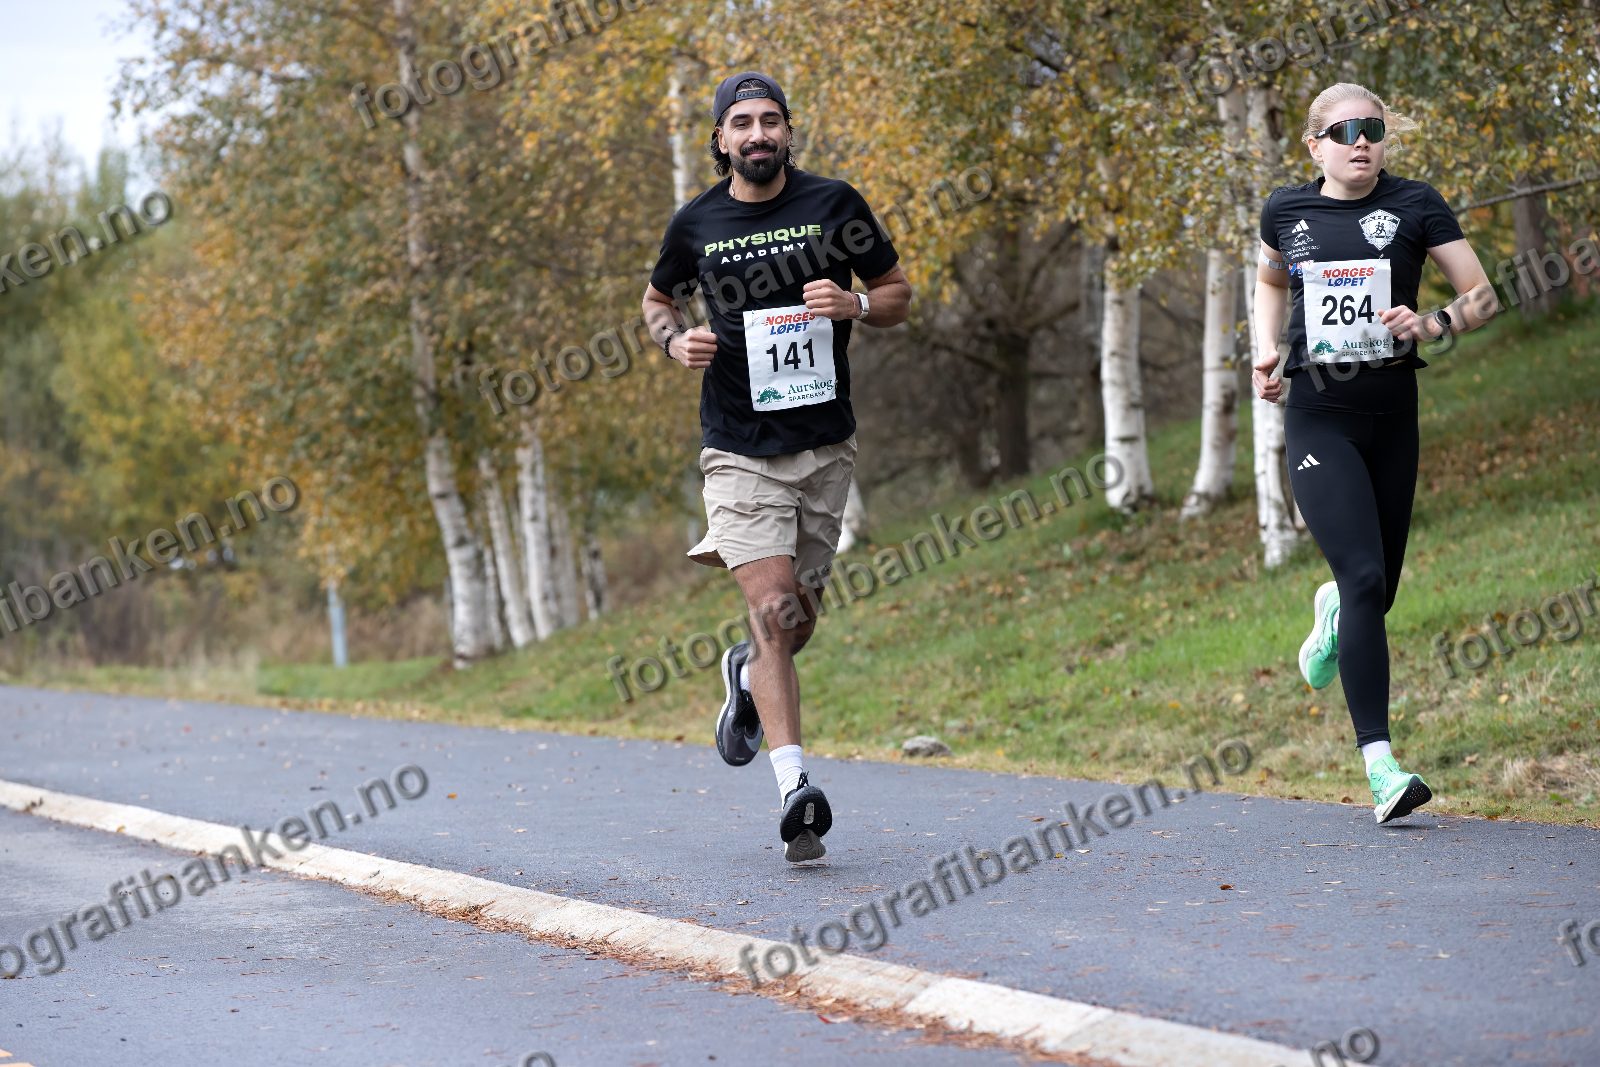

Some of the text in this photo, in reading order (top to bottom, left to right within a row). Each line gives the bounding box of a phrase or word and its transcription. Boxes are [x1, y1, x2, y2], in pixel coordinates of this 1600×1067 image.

[704, 224, 822, 257] PHYSIQUE
[720, 242, 806, 264] ACADEMY
[1322, 267, 1375, 278] NORGES
[1327, 277, 1367, 287] LØPET
[1321, 294, 1375, 326] 264
[765, 312, 816, 326] NORGES
[770, 322, 809, 335] LØPET
[1342, 338, 1389, 350] Aurskog
[766, 338, 815, 373] 141
[787, 379, 834, 395] Aurskog
